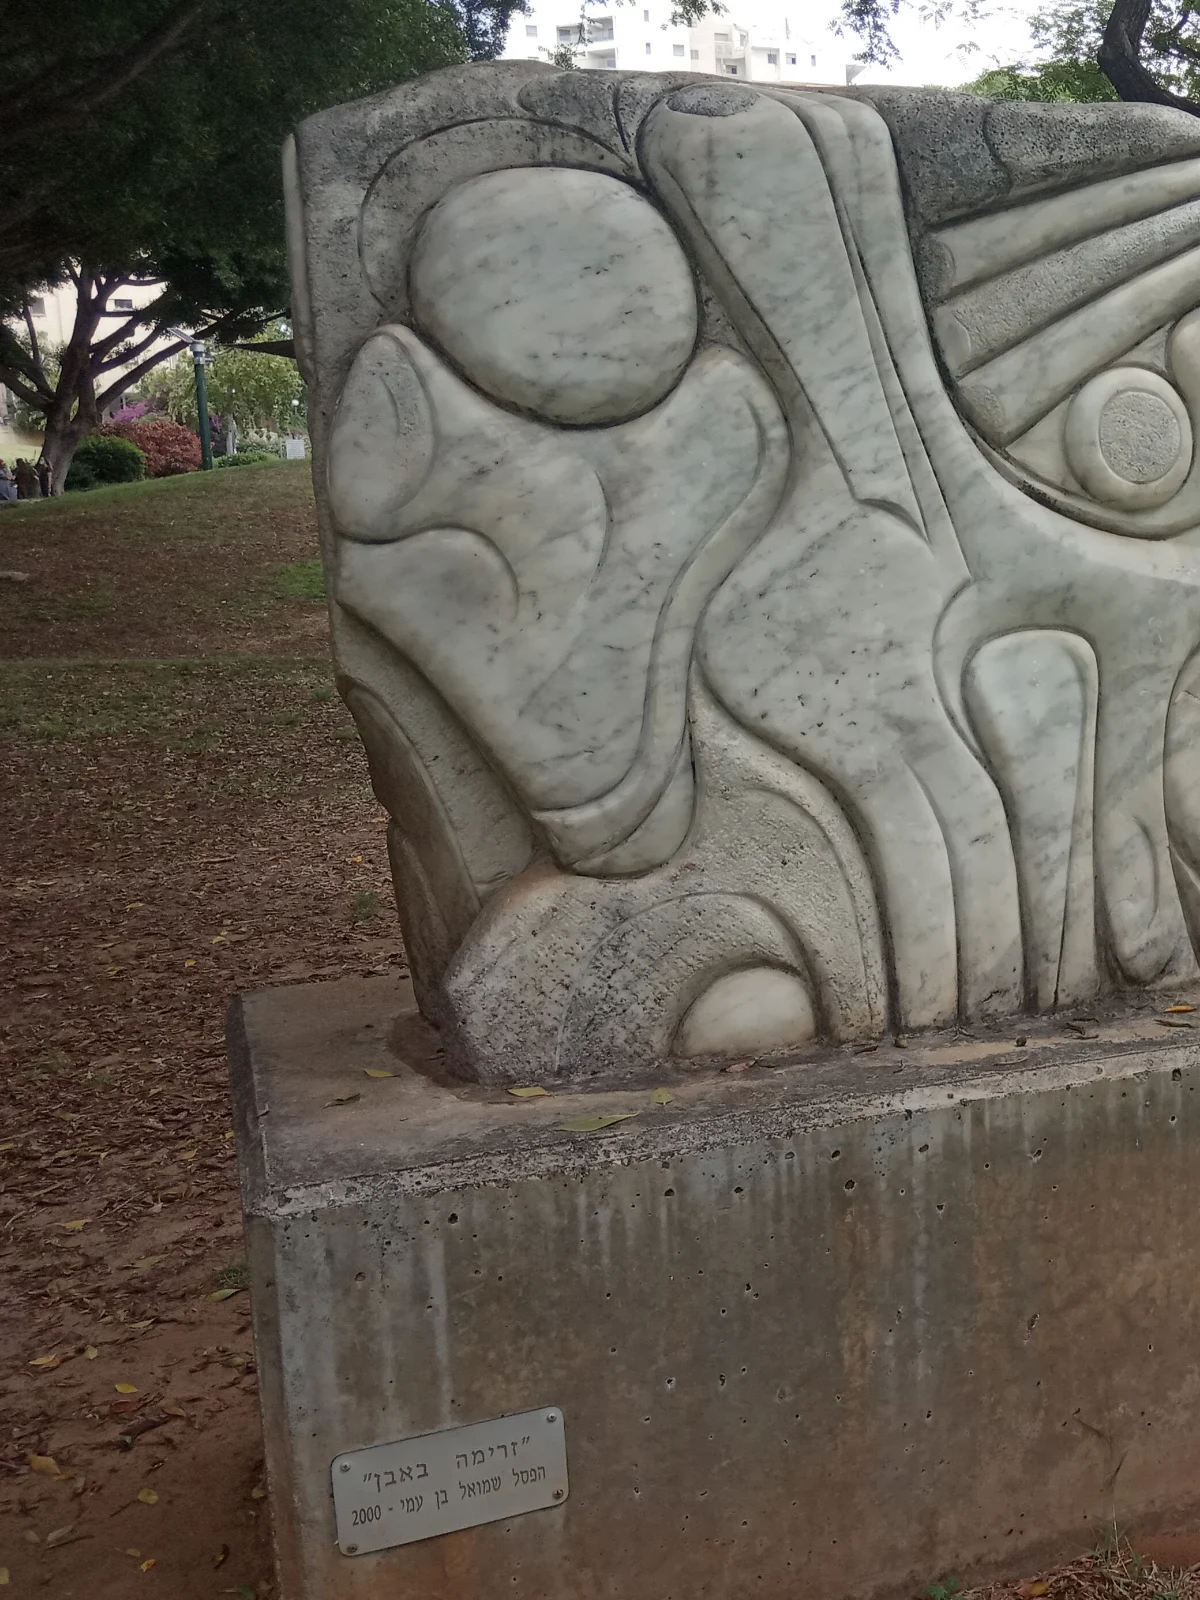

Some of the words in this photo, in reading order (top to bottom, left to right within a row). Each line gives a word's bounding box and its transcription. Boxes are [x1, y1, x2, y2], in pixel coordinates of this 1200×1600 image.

[459, 1474, 502, 1500] שמואל
[511, 1465, 546, 1487] הפסל
[400, 1494, 424, 1514] עמי
[434, 1488, 449, 1510] בן
[351, 1504, 381, 1527] 2000
